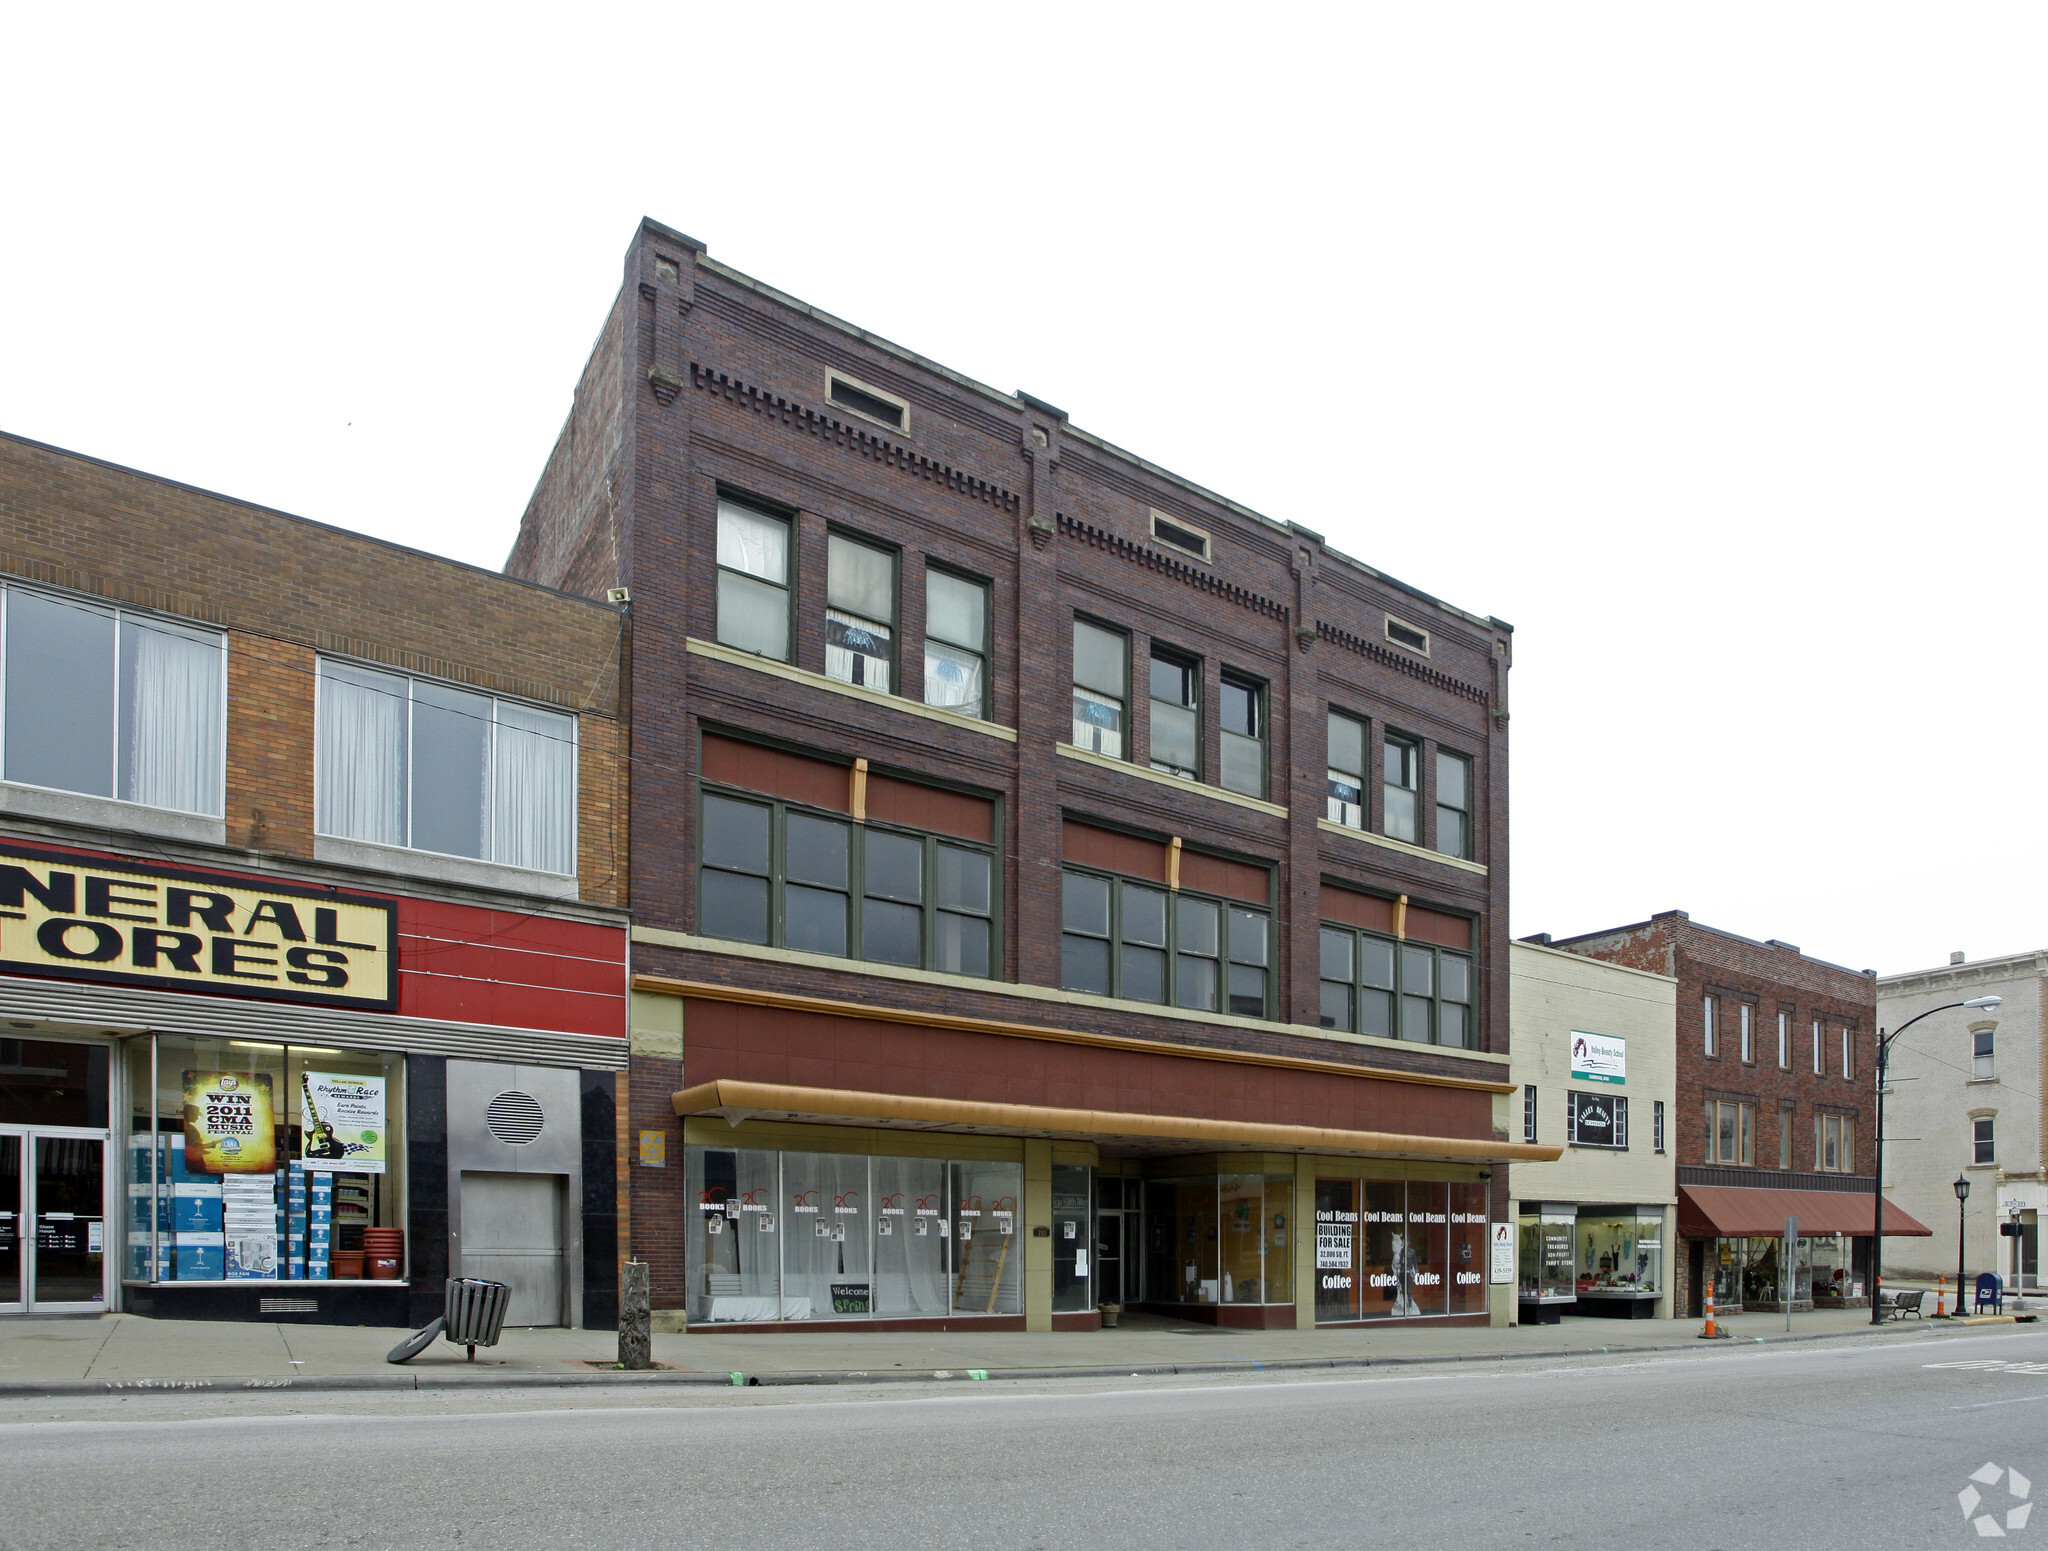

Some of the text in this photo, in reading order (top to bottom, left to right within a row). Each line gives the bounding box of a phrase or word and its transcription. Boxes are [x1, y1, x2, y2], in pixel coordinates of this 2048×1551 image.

[1601, 1047, 1612, 1058] Beauty
[1613, 1049, 1624, 1058] School
[317, 1085, 347, 1094] Rhythm
[356, 1086, 379, 1096] Race
[206, 1094, 252, 1104] WIN
[206, 1106, 252, 1115] 2011
[207, 1116, 252, 1124] CMA
[1316, 1210, 1358, 1222] Cool Beans
[1364, 1211, 1403, 1223] Cool Beans
[1409, 1212, 1446, 1223] Cool Beans
[1451, 1212, 1486, 1224] Cool Beans
[1318, 1225, 1351, 1236] BUILDING
[1319, 1237, 1350, 1248] FOR SALE
[1322, 1275, 1352, 1289] Coffee
[1370, 1274, 1397, 1287] Coffee
[1414, 1272, 1440, 1285] Coffee
[1456, 1271, 1481, 1285] Coffee
[832, 1286, 869, 1296] Welcome
